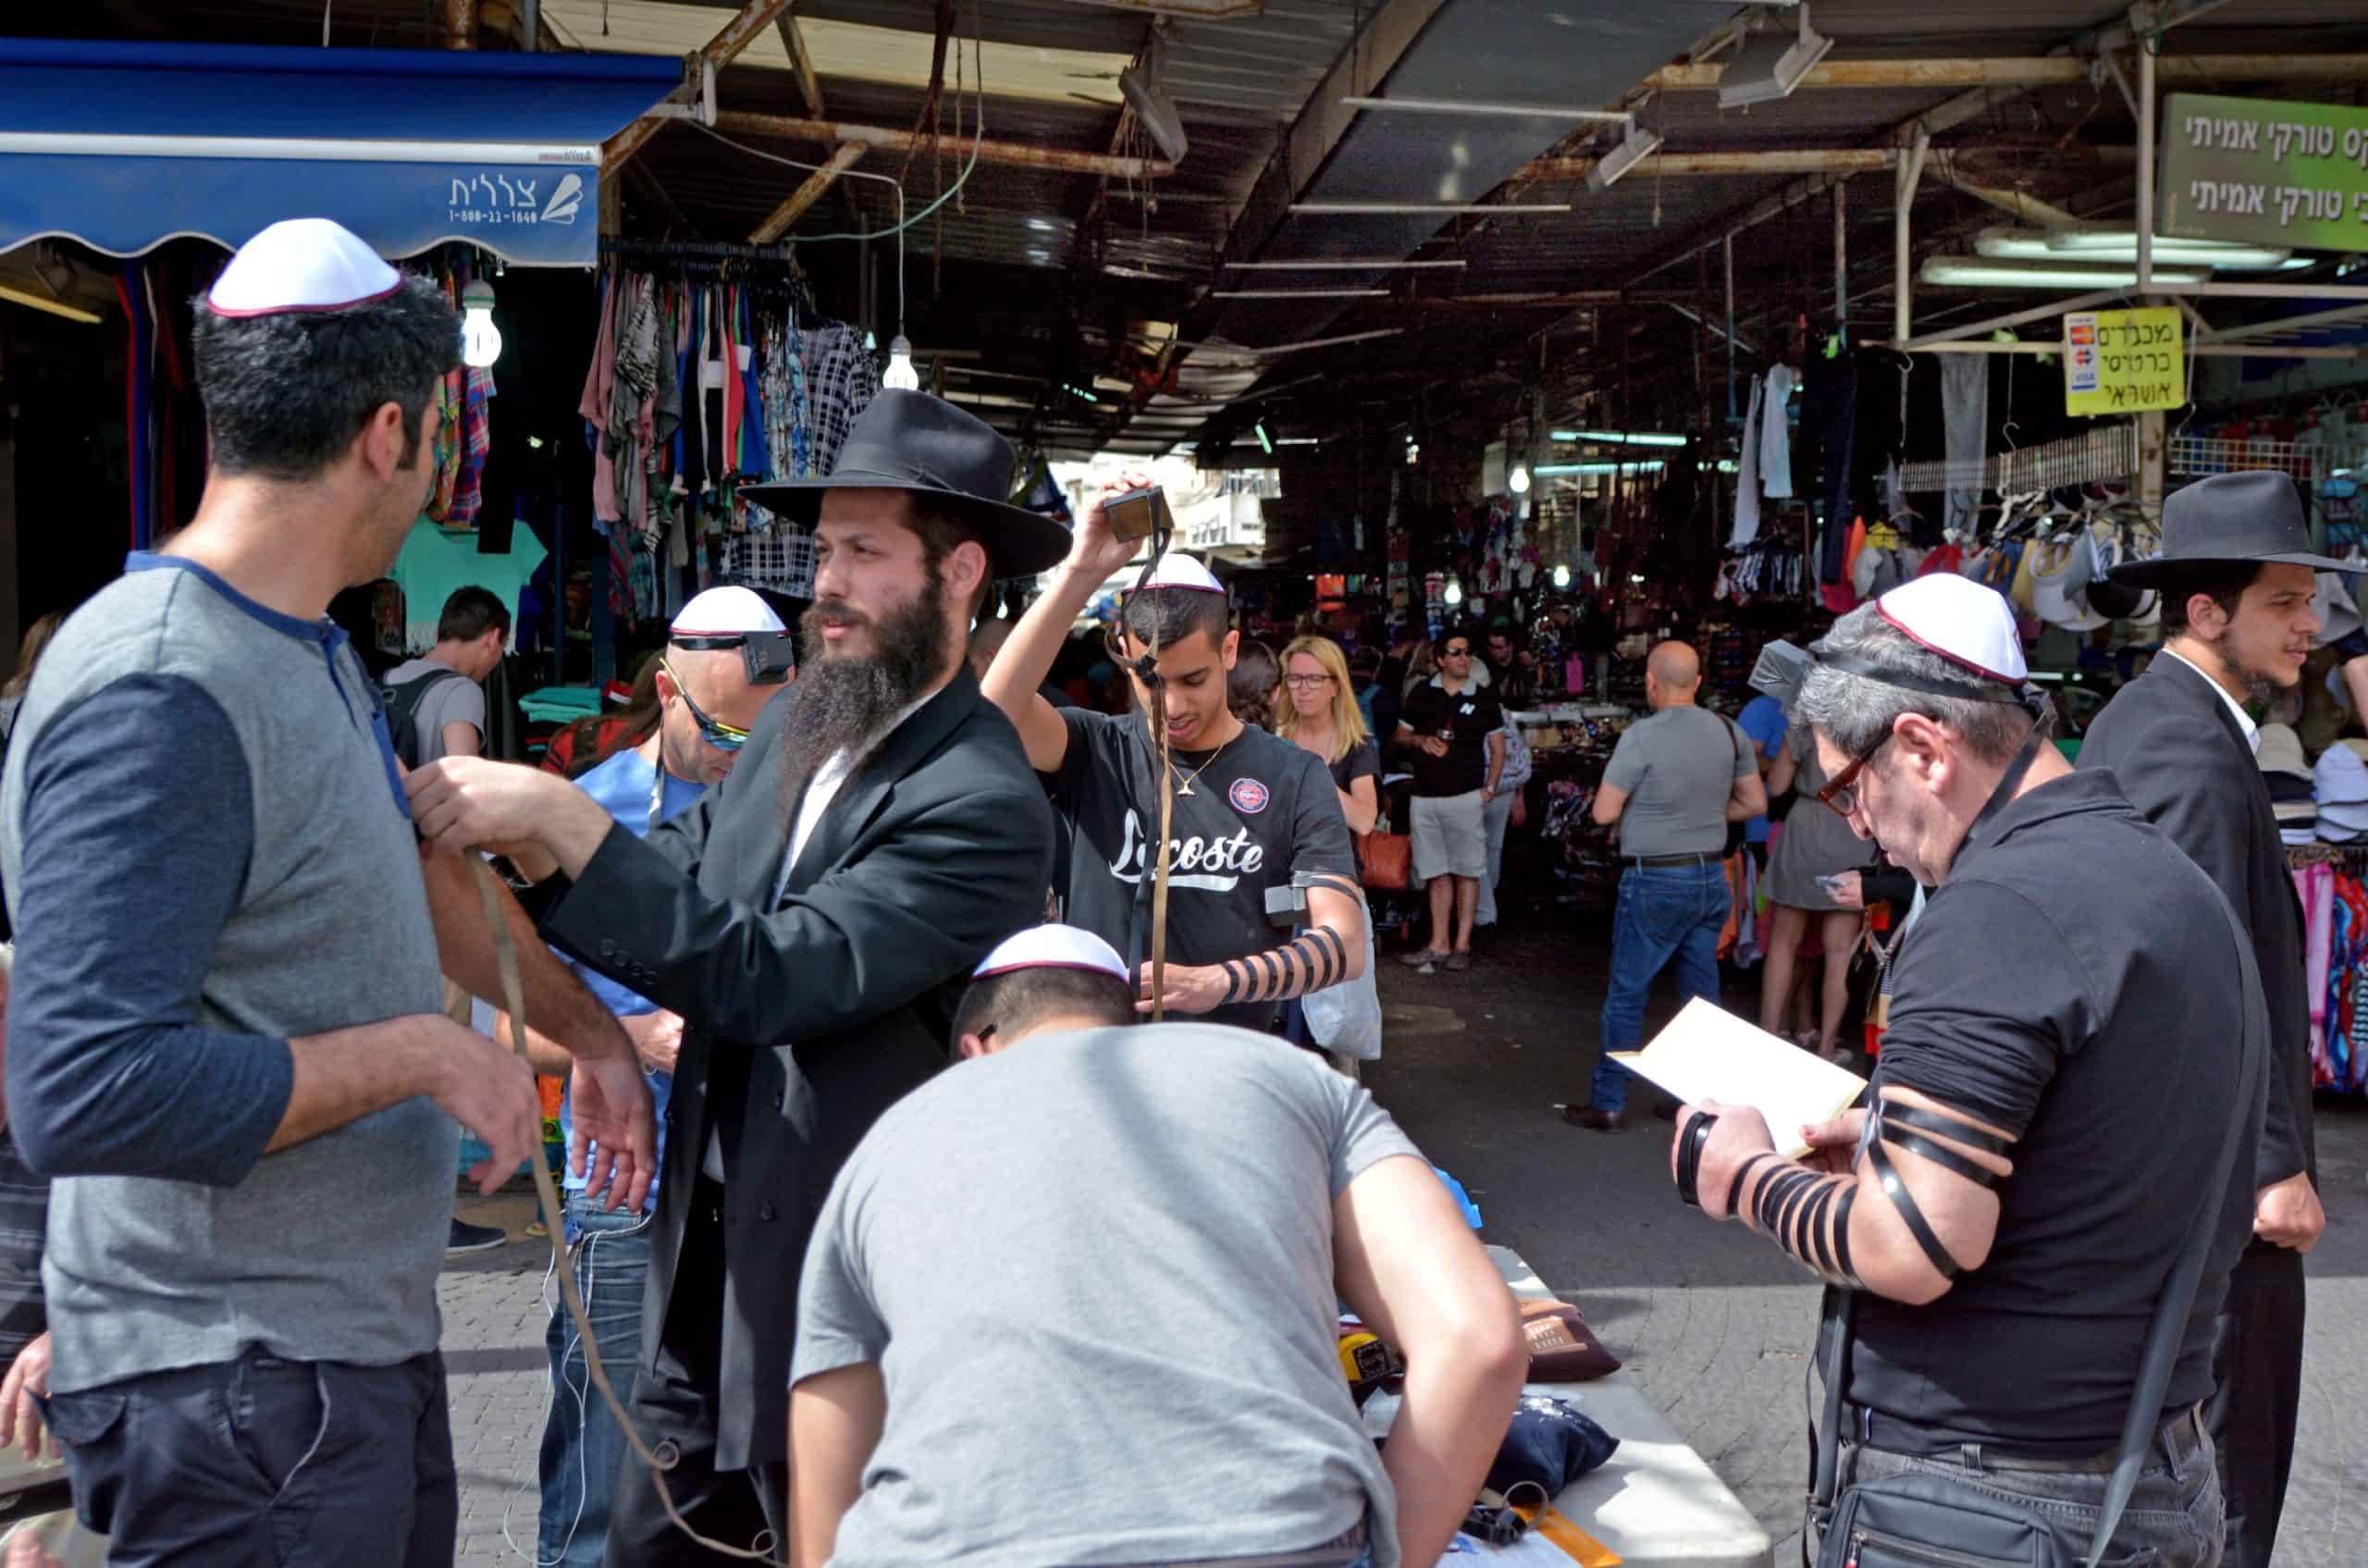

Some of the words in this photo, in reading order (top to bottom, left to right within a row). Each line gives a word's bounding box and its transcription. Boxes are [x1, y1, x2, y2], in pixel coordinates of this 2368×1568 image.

[2185, 117, 2258, 150] אמיתי
[2267, 122, 2334, 162] טורקי
[449, 173, 536, 208] צללית
[2190, 179, 2265, 215] אמיתי
[2274, 186, 2343, 226] טורקי
[2102, 352, 2170, 373] כרטיסי
[2103, 382, 2171, 406] אשראי
